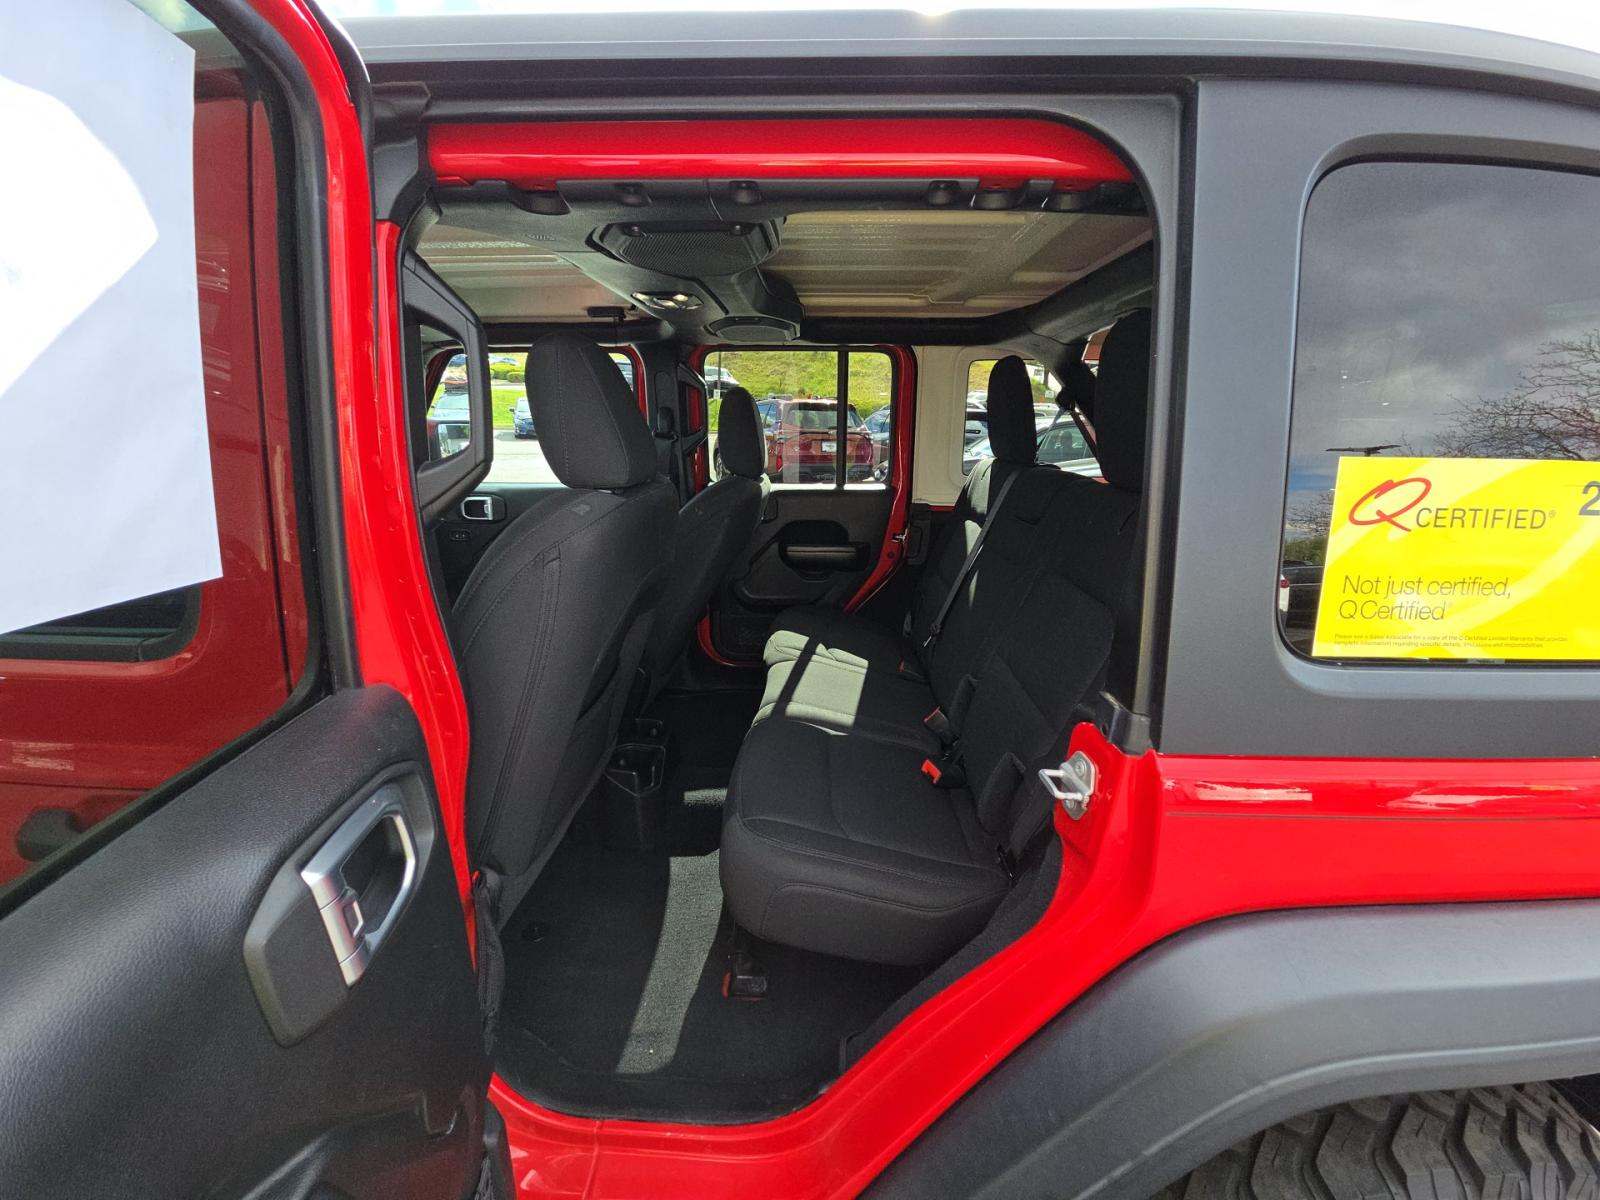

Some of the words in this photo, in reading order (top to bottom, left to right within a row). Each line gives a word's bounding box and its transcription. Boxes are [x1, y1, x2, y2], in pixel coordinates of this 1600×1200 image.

[1348, 477, 1432, 532] Q
[1342, 575, 1381, 595] Not
[1384, 576, 1423, 599] just
[1426, 577, 1511, 599] certified,
